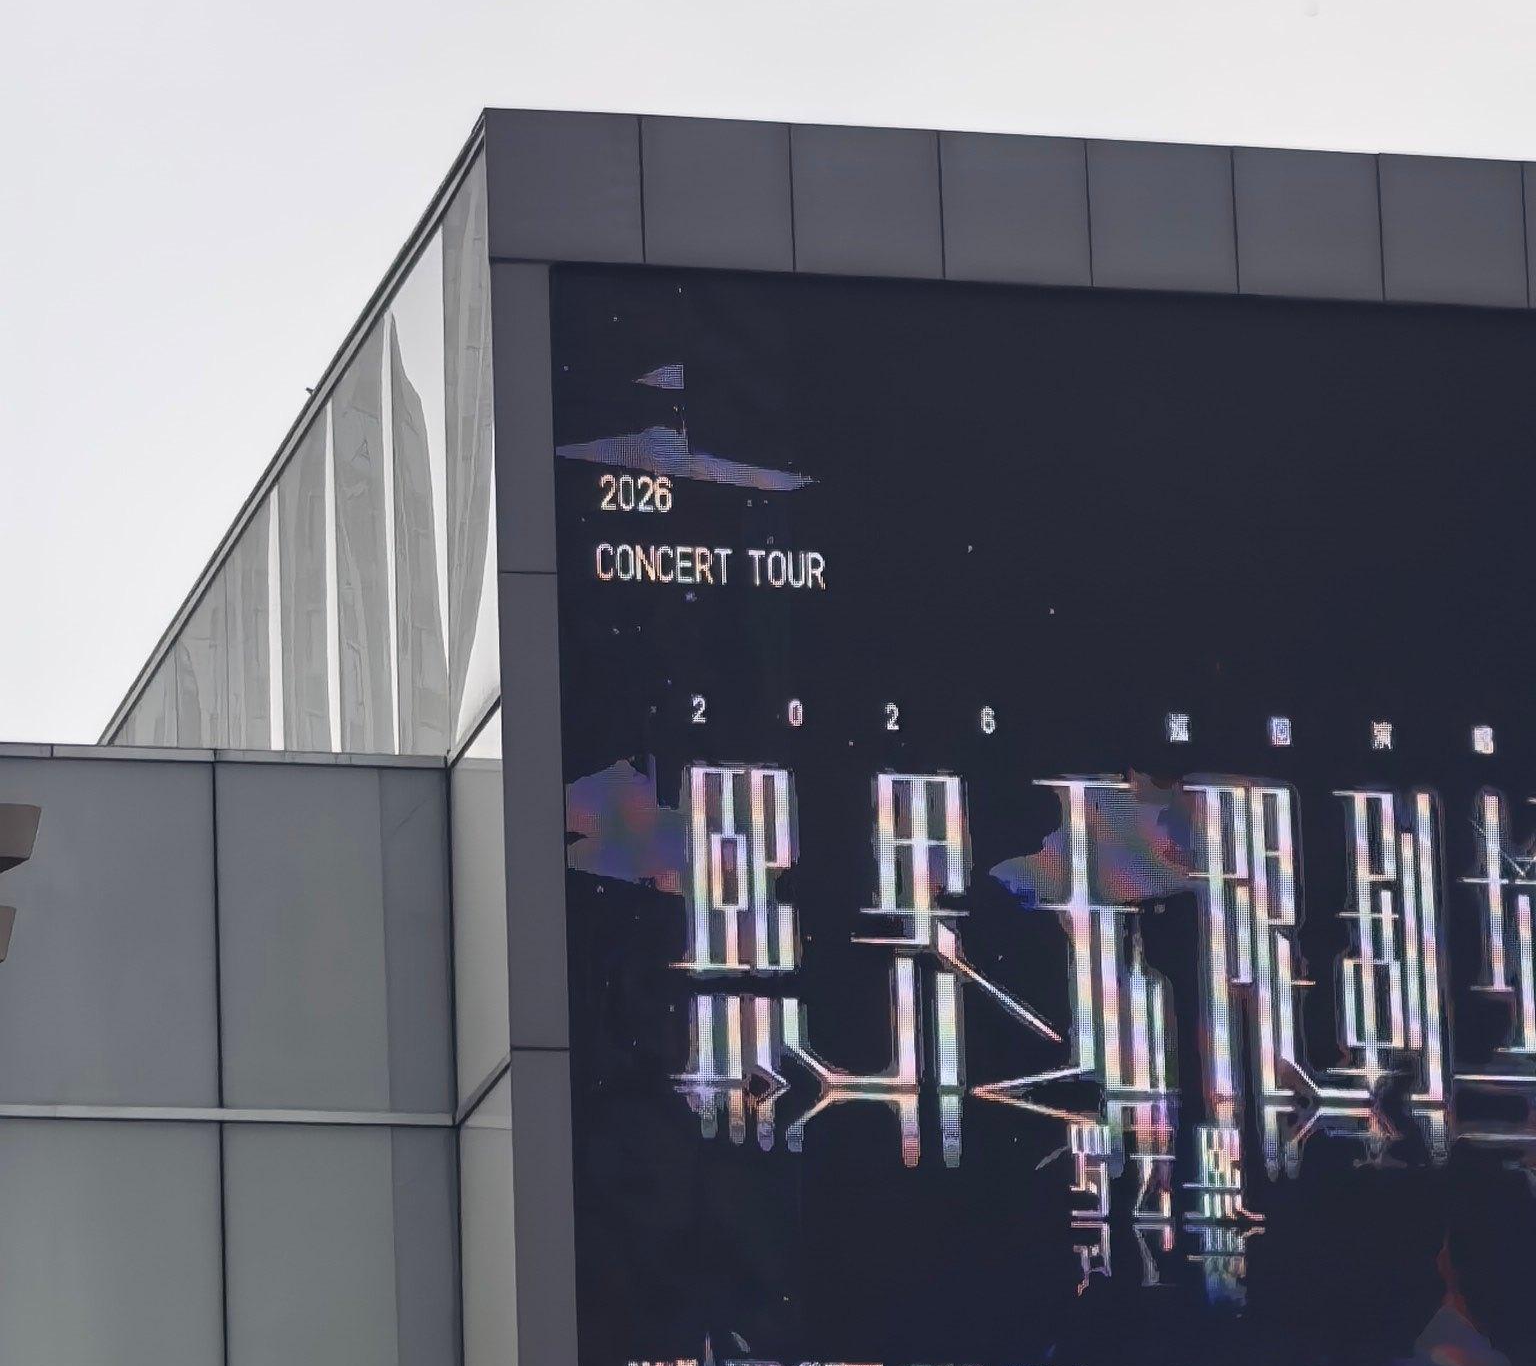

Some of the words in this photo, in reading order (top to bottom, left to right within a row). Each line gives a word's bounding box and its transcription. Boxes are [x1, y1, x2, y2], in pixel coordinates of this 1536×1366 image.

[600, 475, 674, 513] 2026
[595, 543, 732, 585] CONCERT
[748, 550, 826, 589] TOUR
